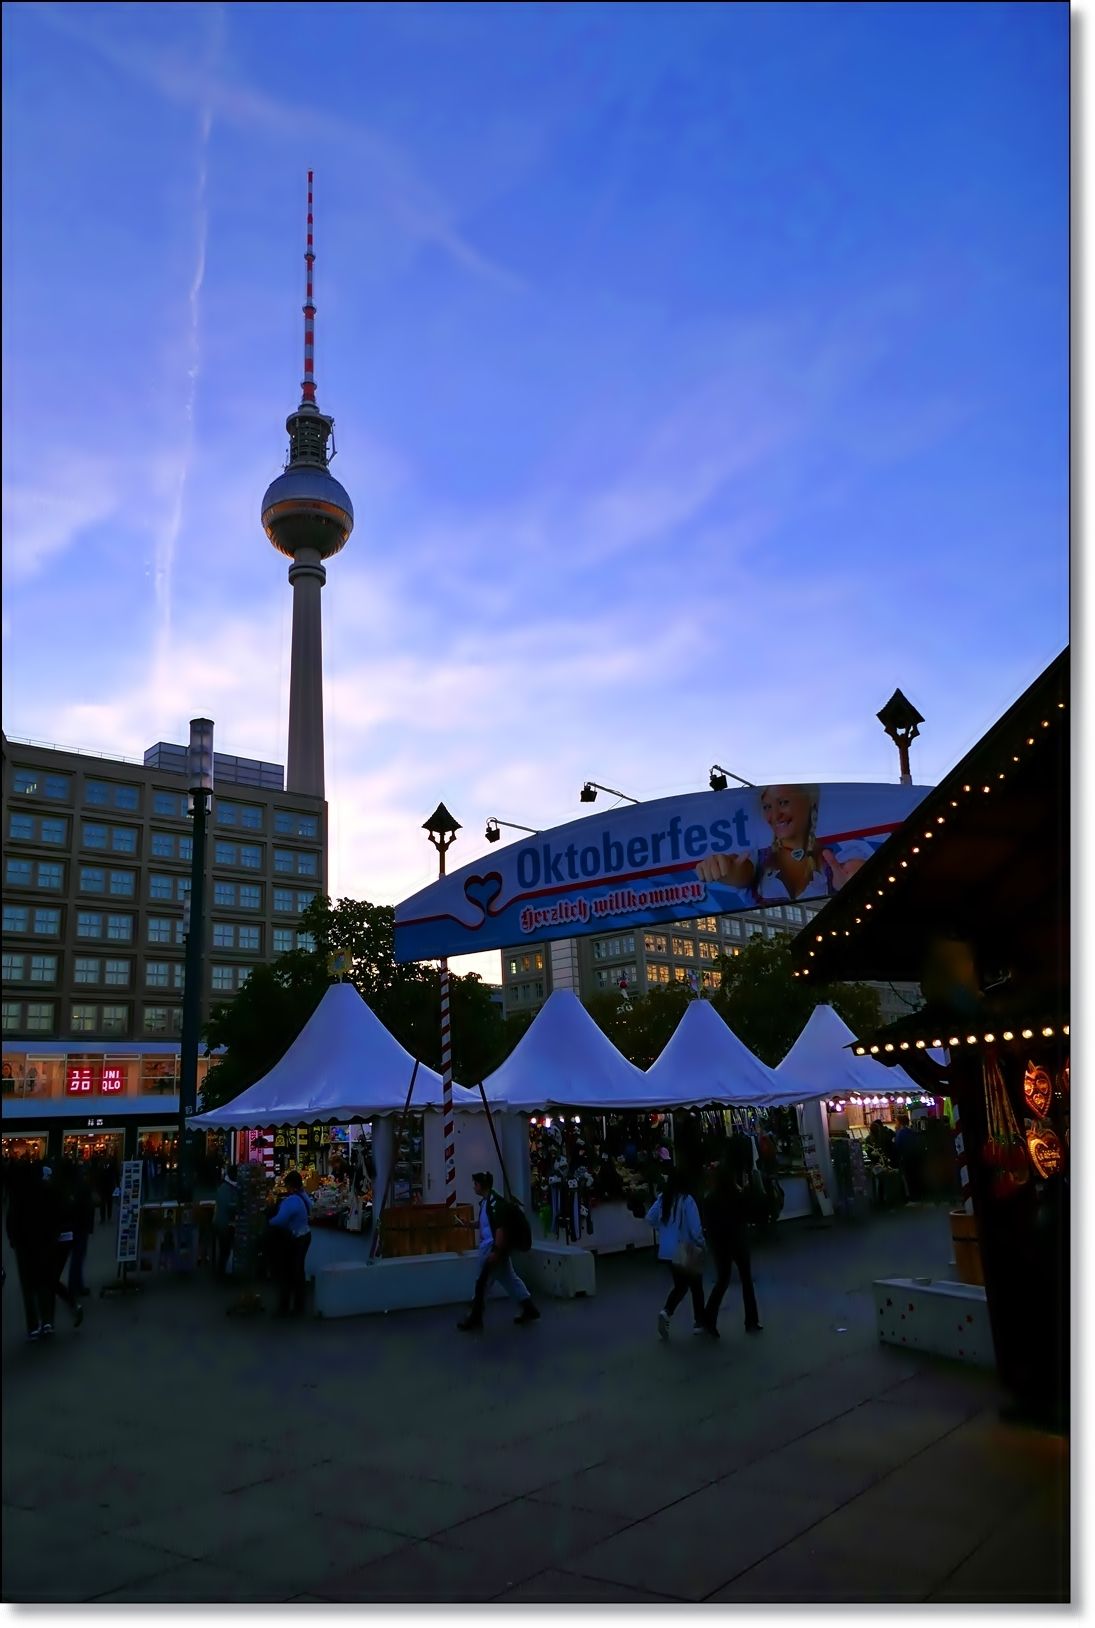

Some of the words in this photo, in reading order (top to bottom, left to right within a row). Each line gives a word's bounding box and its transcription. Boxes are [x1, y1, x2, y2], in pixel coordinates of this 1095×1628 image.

[517, 808, 751, 888] Oktoberfest
[520, 899, 588, 931] Herzlich
[593, 883, 704, 914] willkommen
[102, 1080, 121, 1091] QLO
